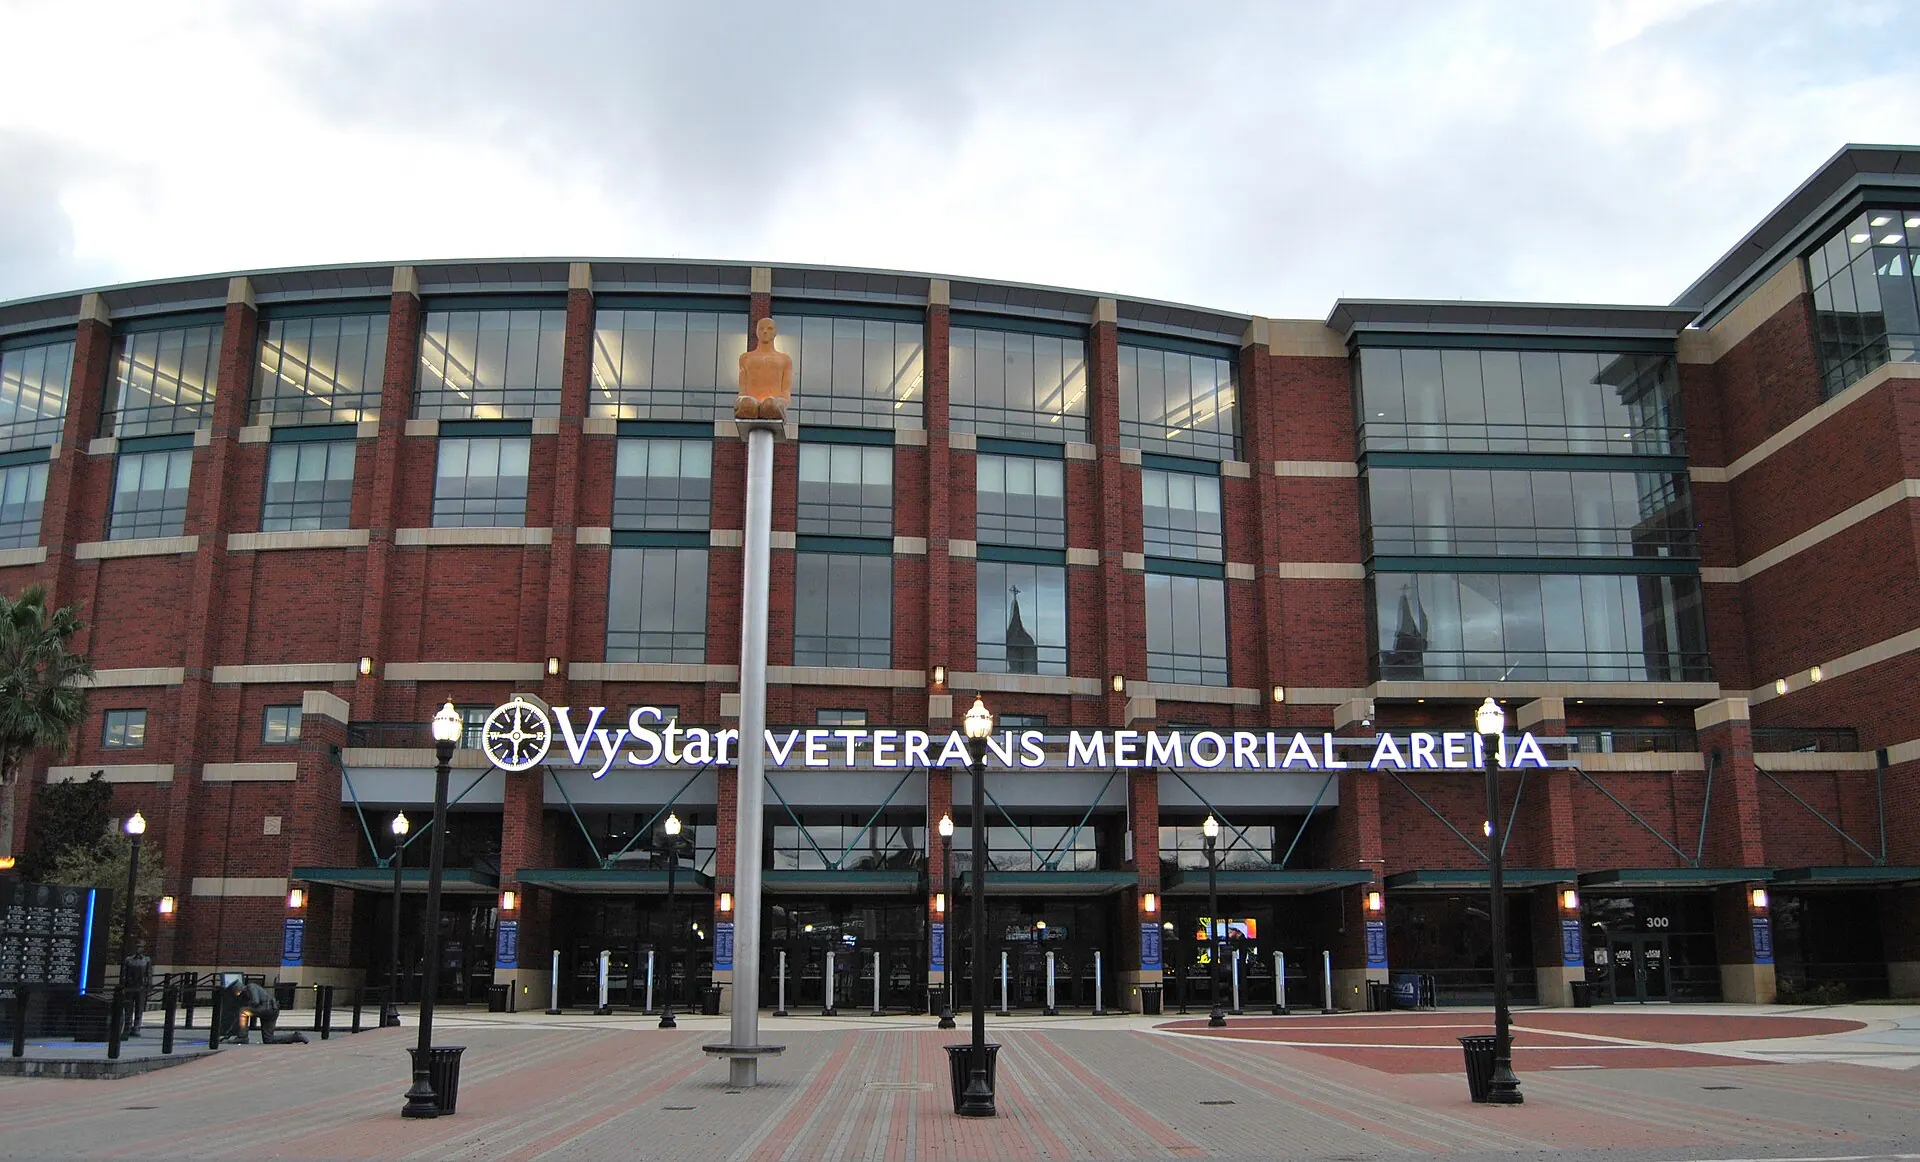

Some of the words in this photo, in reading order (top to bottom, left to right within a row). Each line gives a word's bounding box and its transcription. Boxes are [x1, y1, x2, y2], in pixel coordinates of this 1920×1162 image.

[551, 706, 739, 779] VyStar
[764, 729, 1045, 767] VETERANS
[1067, 730, 1347, 769] MEMORIAL
[1370, 732, 1549, 768] ARENA
[1646, 917, 1669, 928] 300
